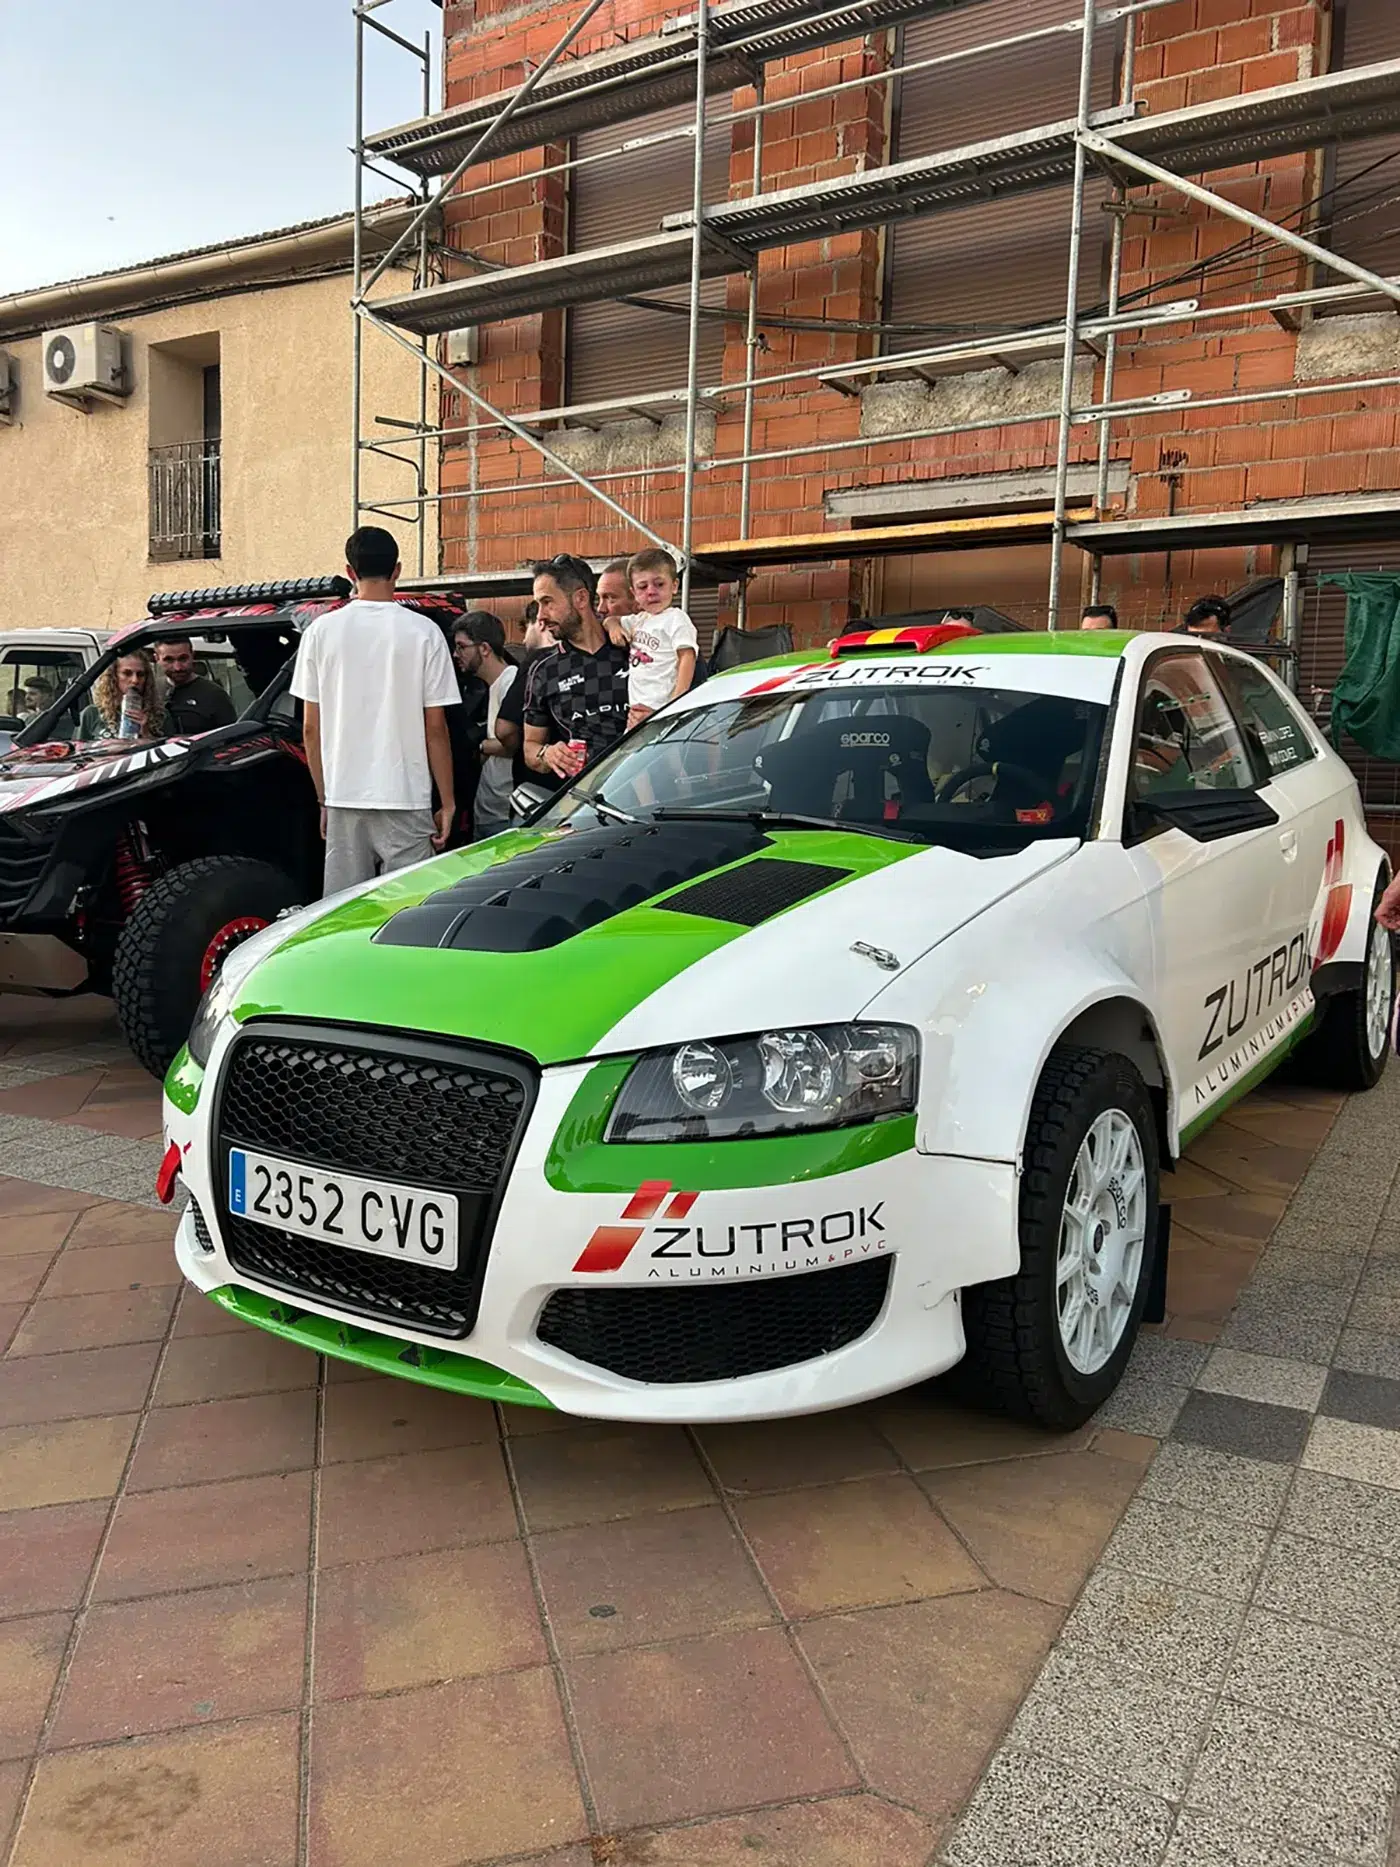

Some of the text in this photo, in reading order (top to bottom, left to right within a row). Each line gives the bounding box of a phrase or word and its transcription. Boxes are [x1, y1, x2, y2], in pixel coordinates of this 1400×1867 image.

[795, 665, 985, 684] ZUTROK
[840, 731, 890, 747] sparco
[1197, 921, 1318, 1062] ZUTROK
[1194, 1016, 1284, 1104] ALUMINIUM
[235, 1164, 444, 1255] E 2352 CVG
[650, 1201, 886, 1258] ZUTROK
[648, 1239, 886, 1277] ALUMINIUM & PVC
